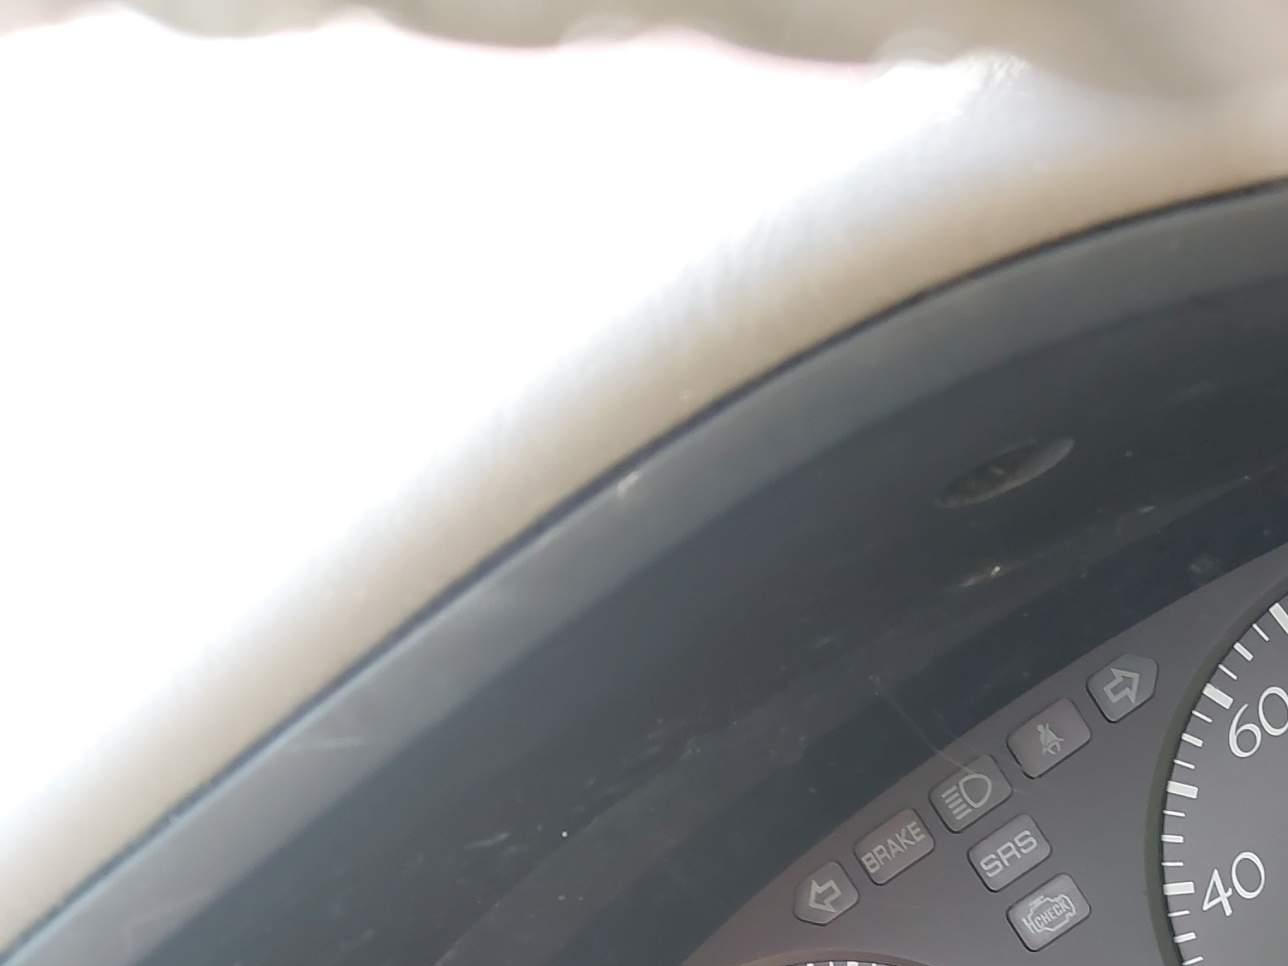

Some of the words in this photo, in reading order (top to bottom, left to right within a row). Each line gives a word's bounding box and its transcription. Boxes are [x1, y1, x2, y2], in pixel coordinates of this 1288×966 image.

[862, 821, 925, 873] BRAKE
[980, 830, 1038, 877] SRS
[1201, 852, 1266, 917] 40
[1033, 901, 1071, 932] CHECK
